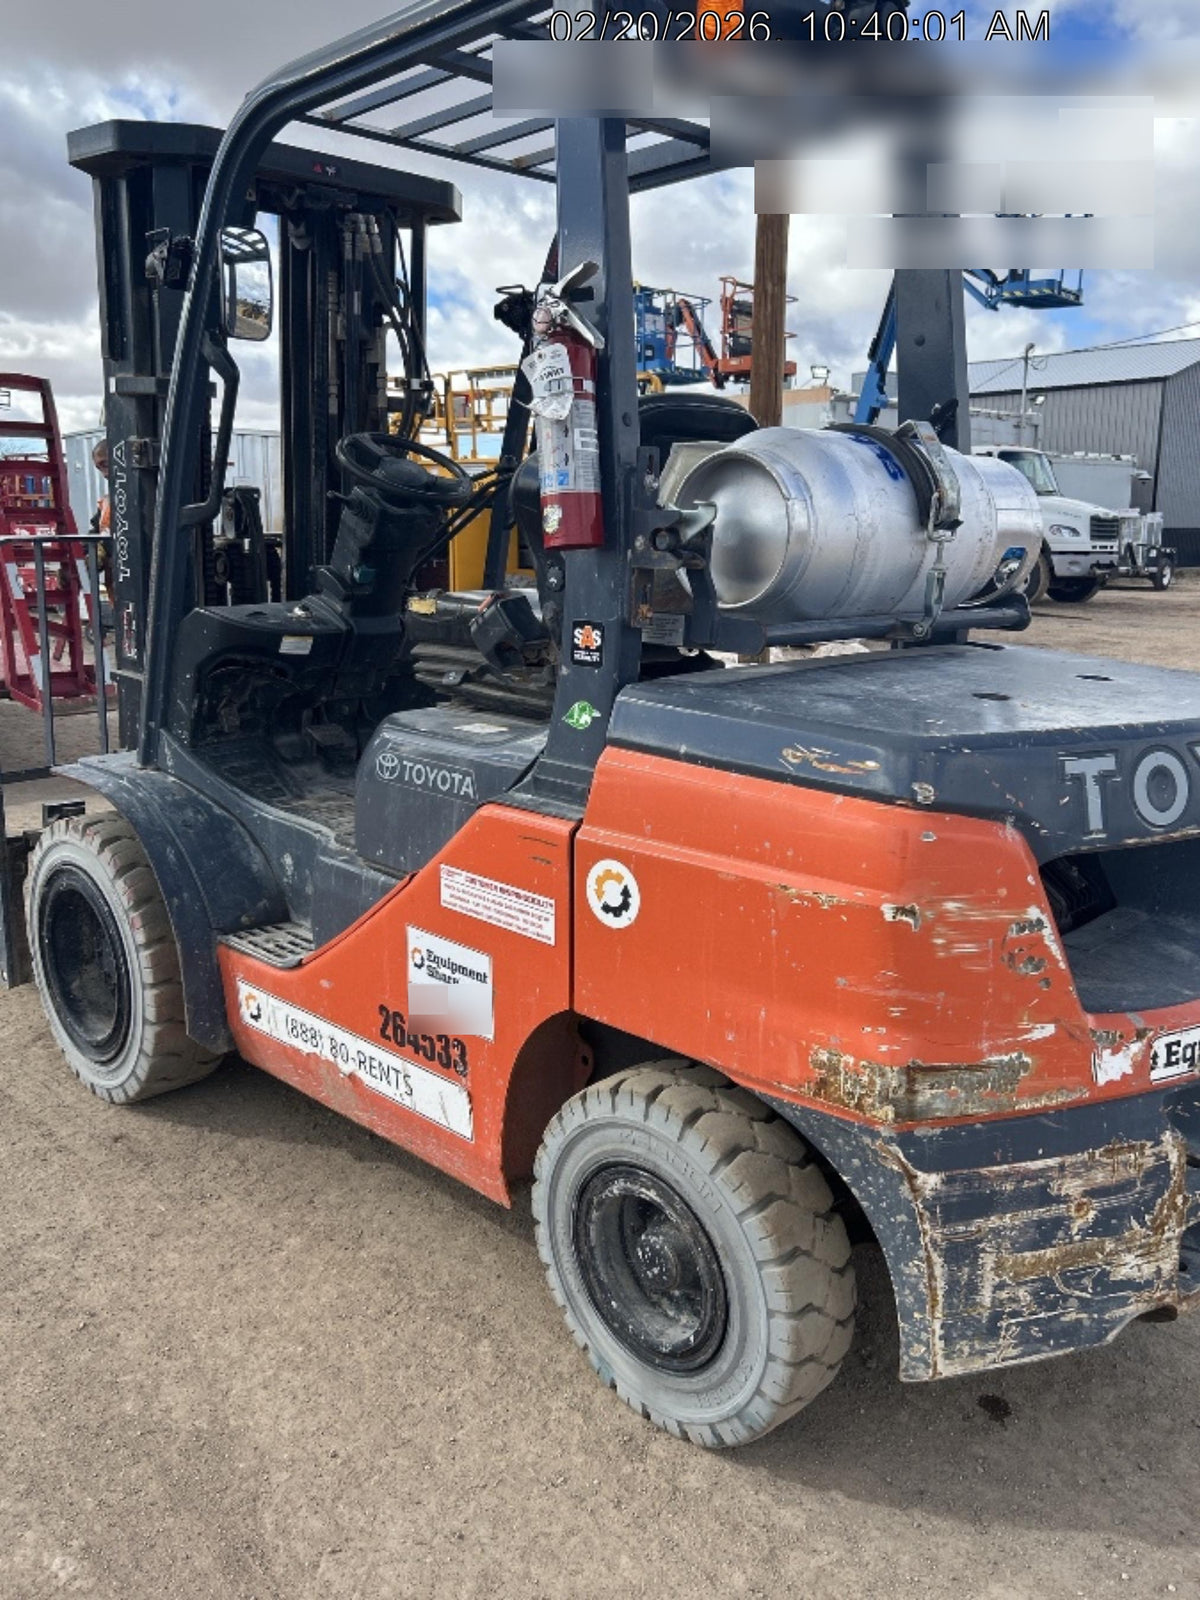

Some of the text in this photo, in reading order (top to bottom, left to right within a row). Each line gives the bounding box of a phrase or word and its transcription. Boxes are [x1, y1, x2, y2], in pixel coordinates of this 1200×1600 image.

[112, 440, 131, 582] TOYOTA
[573, 625, 602, 650] SAS
[402, 760, 475, 800] TOYOTA
[1064, 746, 1200, 831] TO
[426, 948, 488, 984] Equipment
[285, 1014, 414, 1097] (888) 80-RENTS
[1163, 1039, 1200, 1069] Eq
